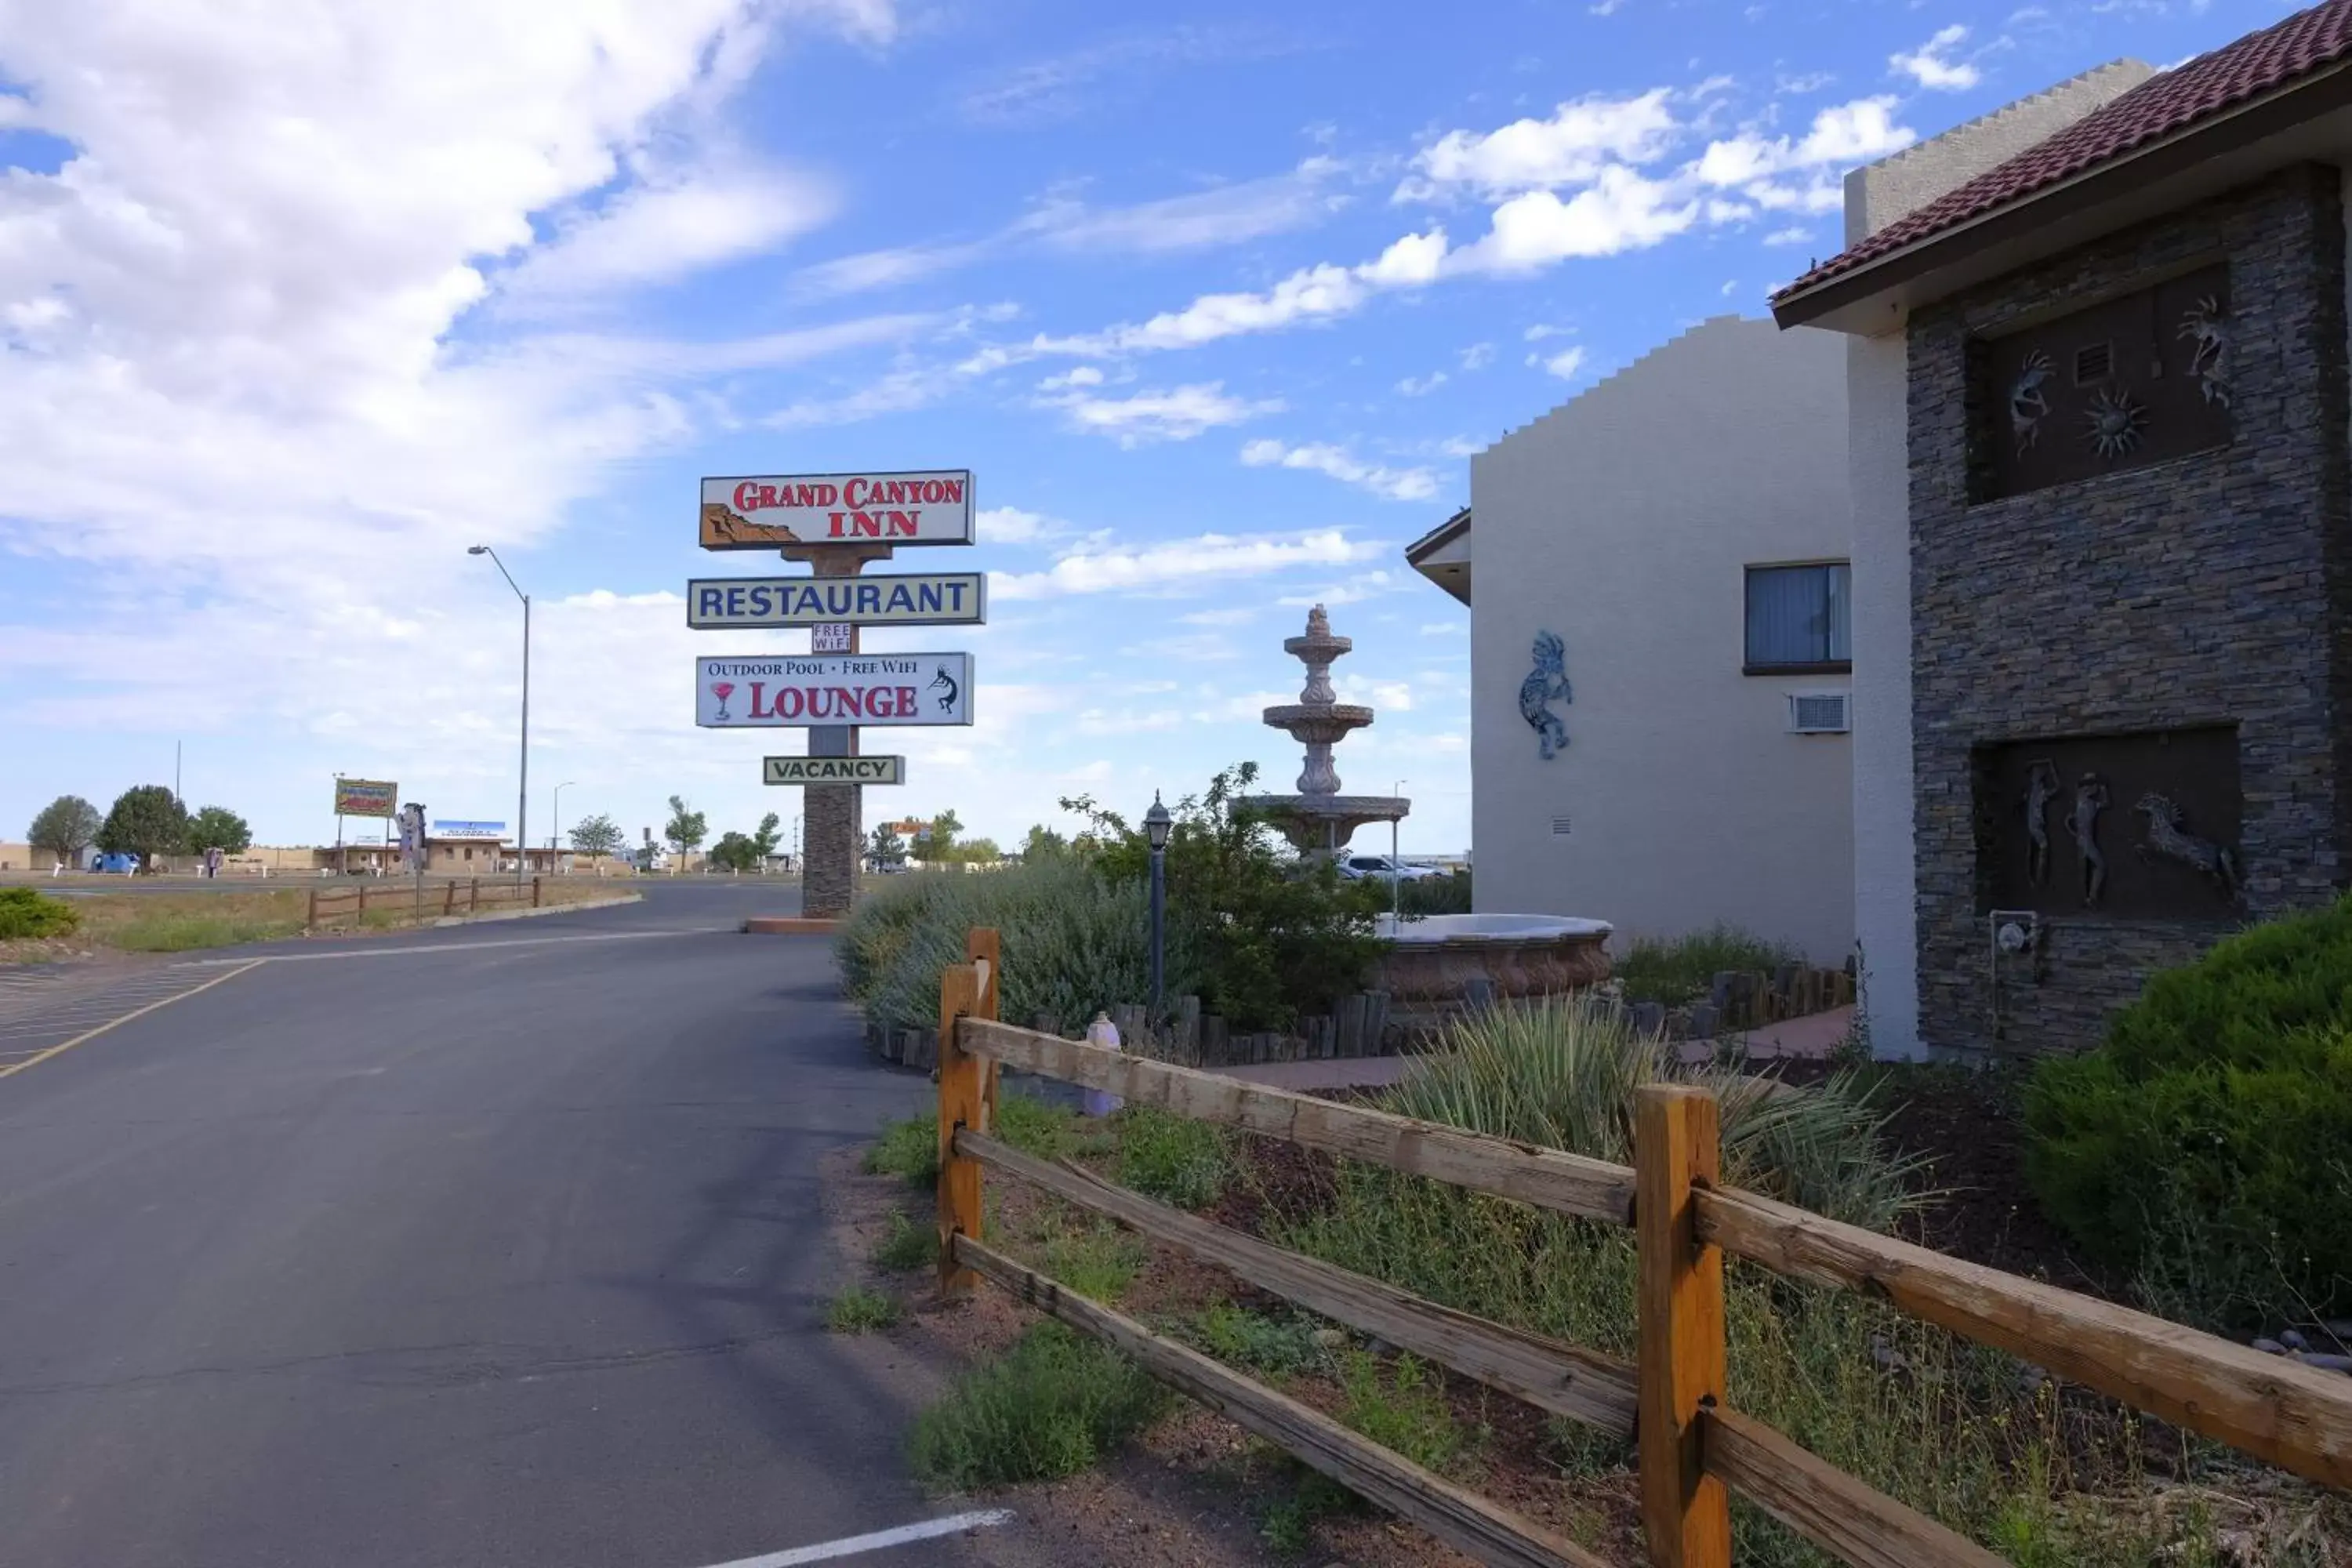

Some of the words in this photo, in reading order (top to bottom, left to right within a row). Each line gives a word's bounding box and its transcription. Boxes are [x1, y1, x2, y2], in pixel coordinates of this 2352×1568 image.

[733, 481, 838, 512] GRAND
[843, 477, 965, 510] CANYON
[827, 510, 922, 538] INN
[699, 582, 969, 617] RESTAURANT
[815, 625, 850, 636] FREE
[708, 662, 782, 677] OUTDOOR
[786, 661, 826, 676] POOL
[842, 660, 879, 675] FREE
[881, 659, 917, 674] WIFI
[747, 682, 919, 719] LOUNGE
[773, 760, 888, 779] VACANCY
